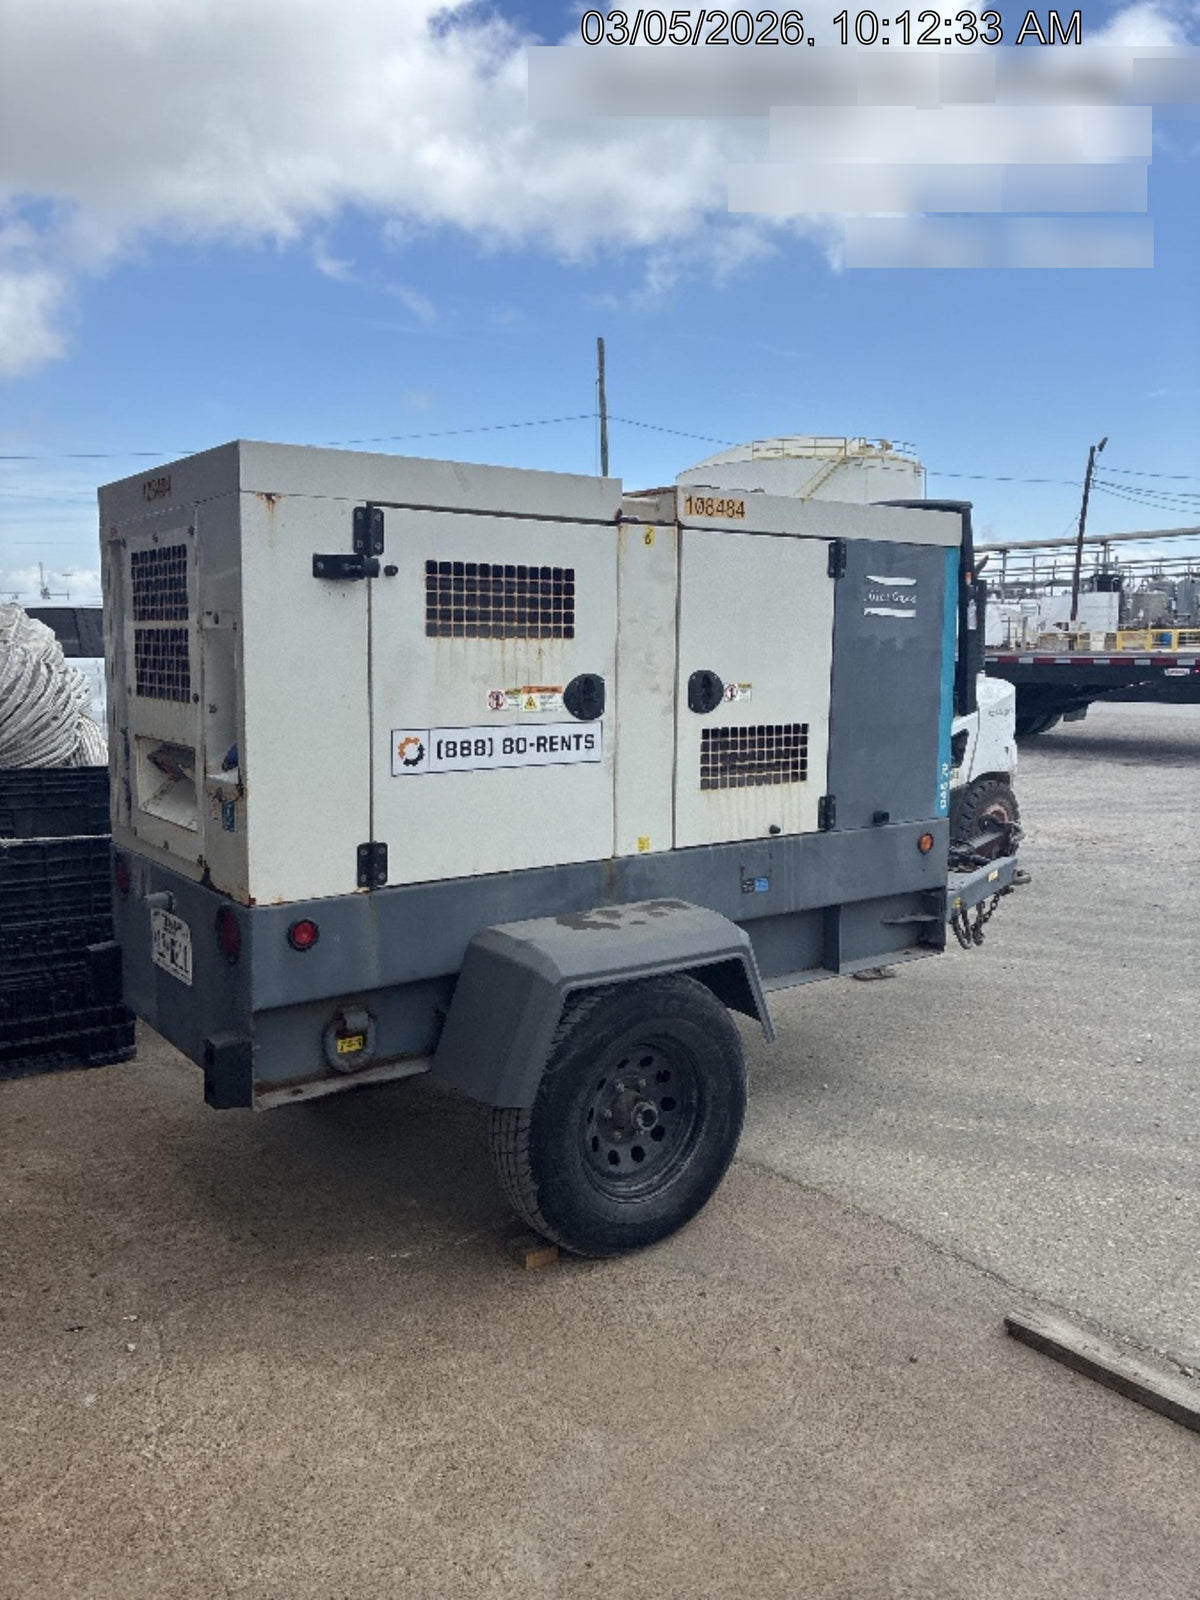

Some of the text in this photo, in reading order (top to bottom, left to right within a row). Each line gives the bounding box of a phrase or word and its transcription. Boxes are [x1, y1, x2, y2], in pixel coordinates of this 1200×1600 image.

[685, 495, 746, 519] 108484
[436, 733, 595, 759] (888) 80-RENTS
